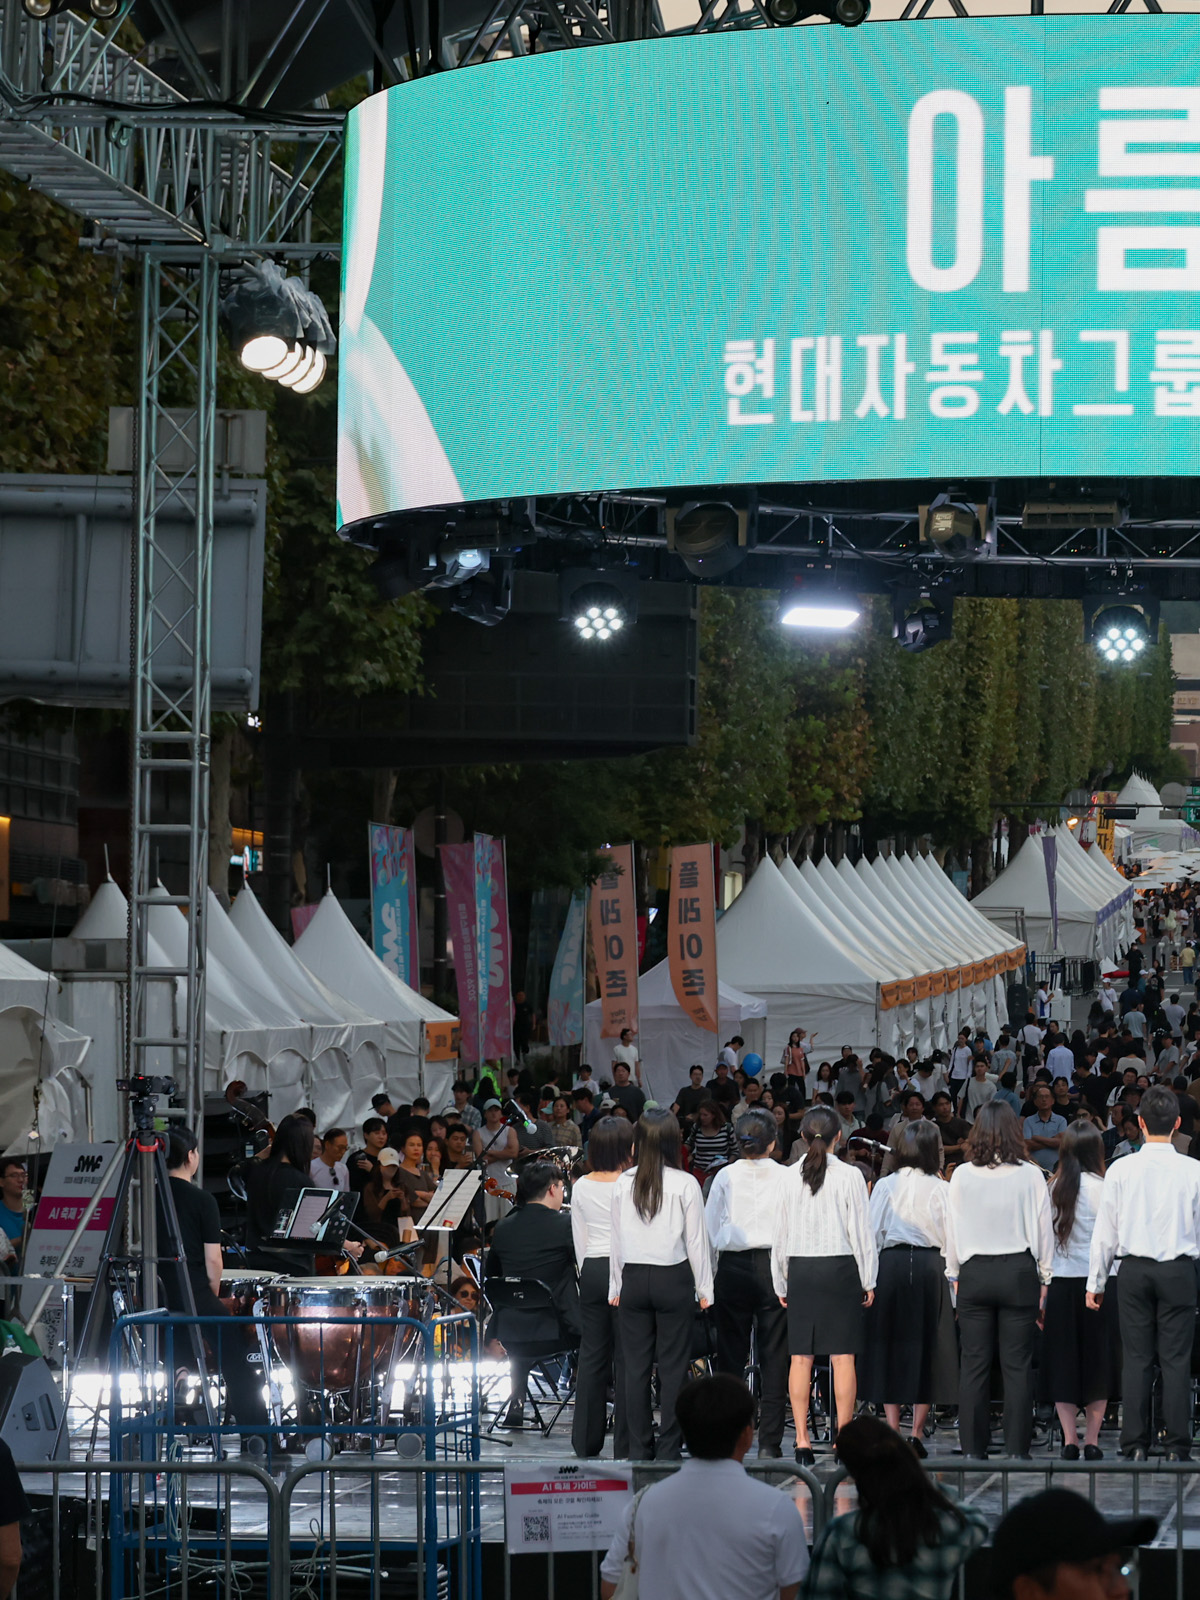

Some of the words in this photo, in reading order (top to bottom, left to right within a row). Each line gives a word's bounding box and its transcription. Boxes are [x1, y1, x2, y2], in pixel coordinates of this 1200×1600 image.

[48, 1208, 60, 1220] AI
[542, 1482, 552, 1492] AI
[573, 1480, 597, 1490] 가이드
